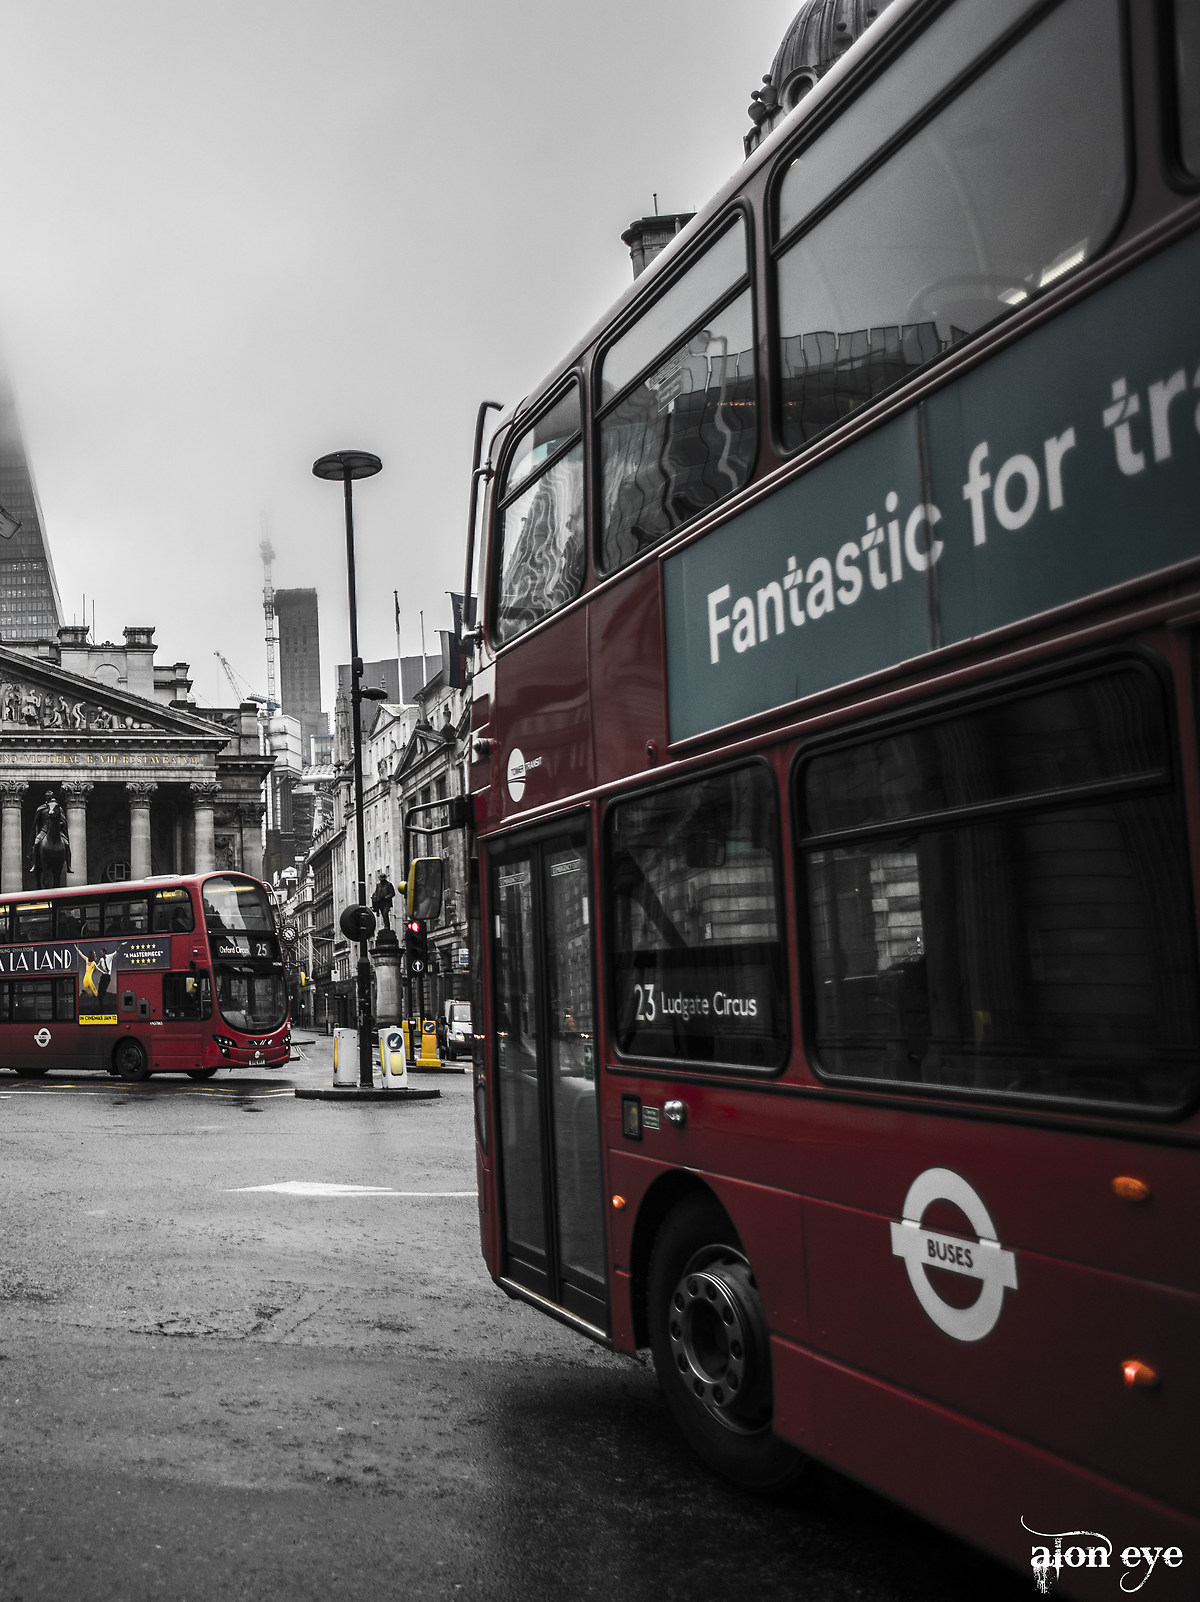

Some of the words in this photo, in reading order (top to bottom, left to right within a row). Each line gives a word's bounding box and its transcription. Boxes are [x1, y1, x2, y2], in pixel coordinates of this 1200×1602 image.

[706, 491, 943, 665] Fantastic
[962, 426, 1077, 547] for
[1102, 364, 1200, 476] tr
[24, 754, 81, 763] VICTORIAE
[10, 952, 29, 972] LA
[34, 949, 72, 971] LAND
[220, 945, 235, 954] Oxford
[256, 943, 268, 956] 25
[634, 984, 656, 1021] 23
[661, 991, 709, 1021] Ludgate
[713, 991, 757, 1016] Circus
[927, 1239, 973, 1268] BUSES
